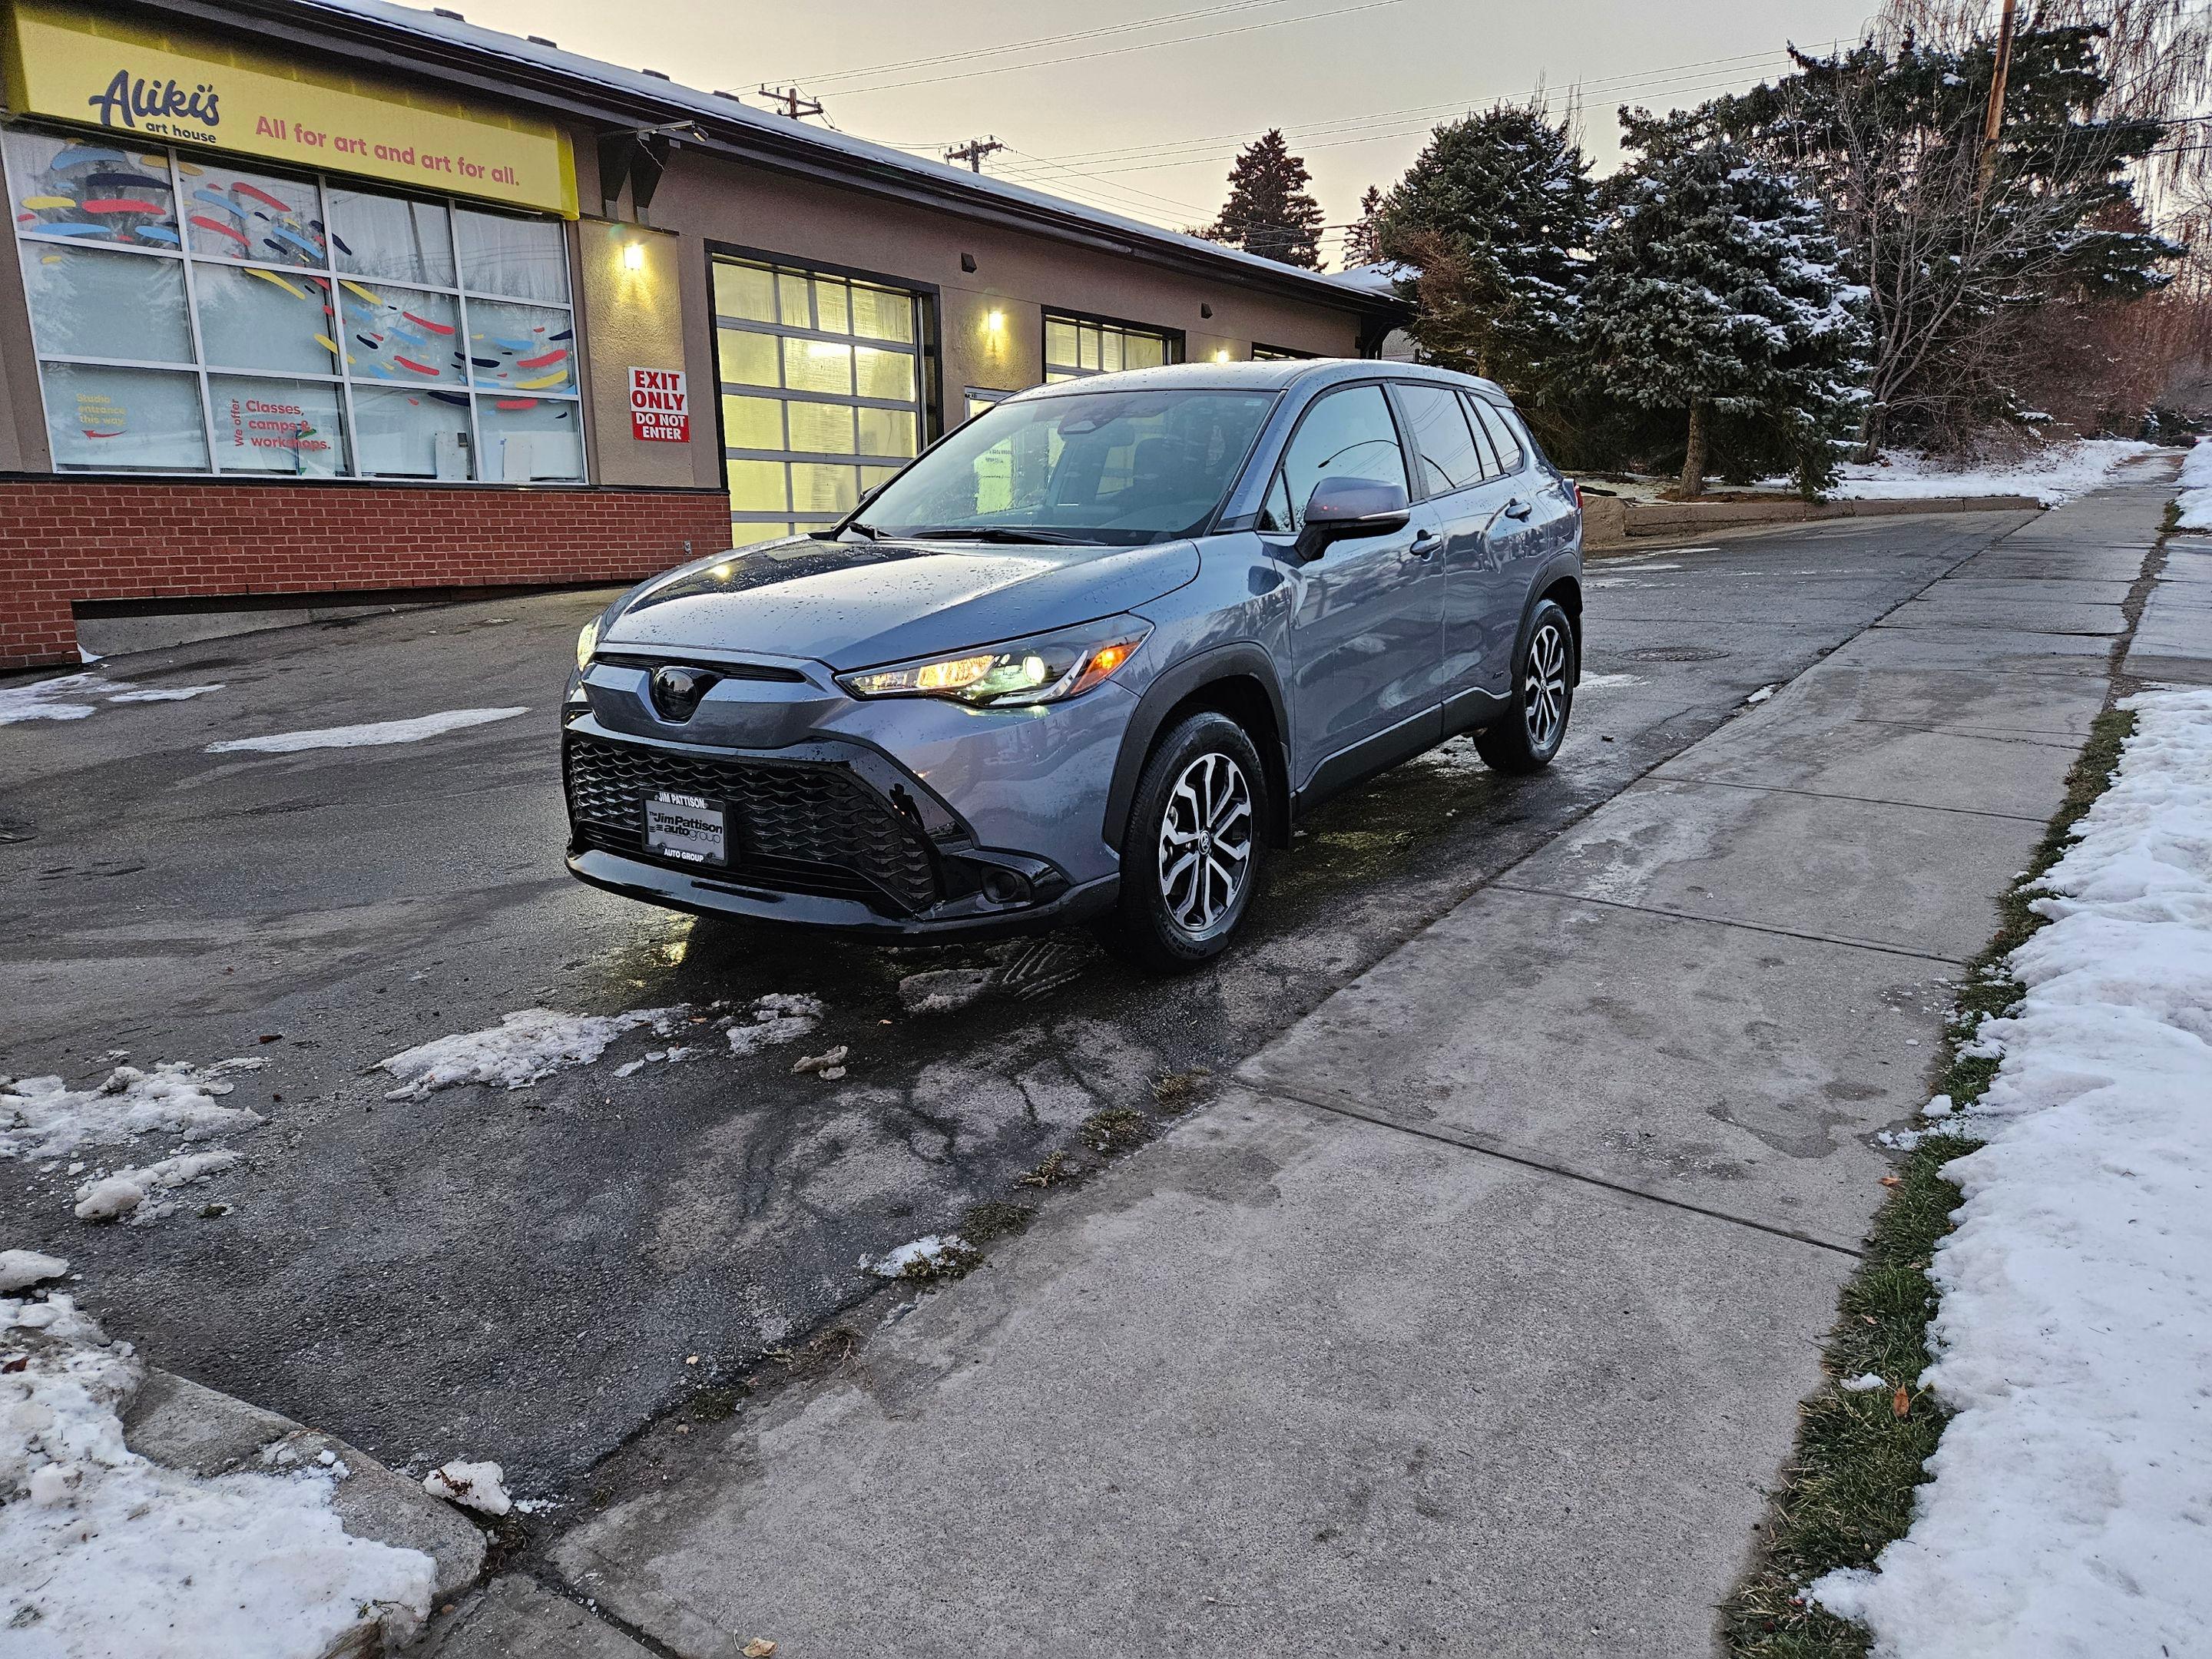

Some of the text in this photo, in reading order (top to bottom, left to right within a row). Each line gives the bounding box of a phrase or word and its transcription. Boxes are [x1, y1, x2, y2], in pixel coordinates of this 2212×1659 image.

[88, 69, 220, 127] Aliki's
[145, 121, 217, 143] art house
[256, 116, 520, 187] All for art and art for all.
[634, 370, 680, 391] EXIT
[76, 393, 111, 404] Studio
[631, 390, 685, 411] ONLY
[246, 399, 304, 416] Classes,
[80, 415, 100, 424] this
[230, 399, 244, 447] We offer
[248, 420, 311, 433] camps &
[635, 412, 685, 428] DO NOT
[642, 426, 682, 440] ENTER
[250, 435, 332, 452] workshops.
[658, 792, 706, 809] JIM PATTISON
[664, 848, 704, 863] AUTO GROUP
